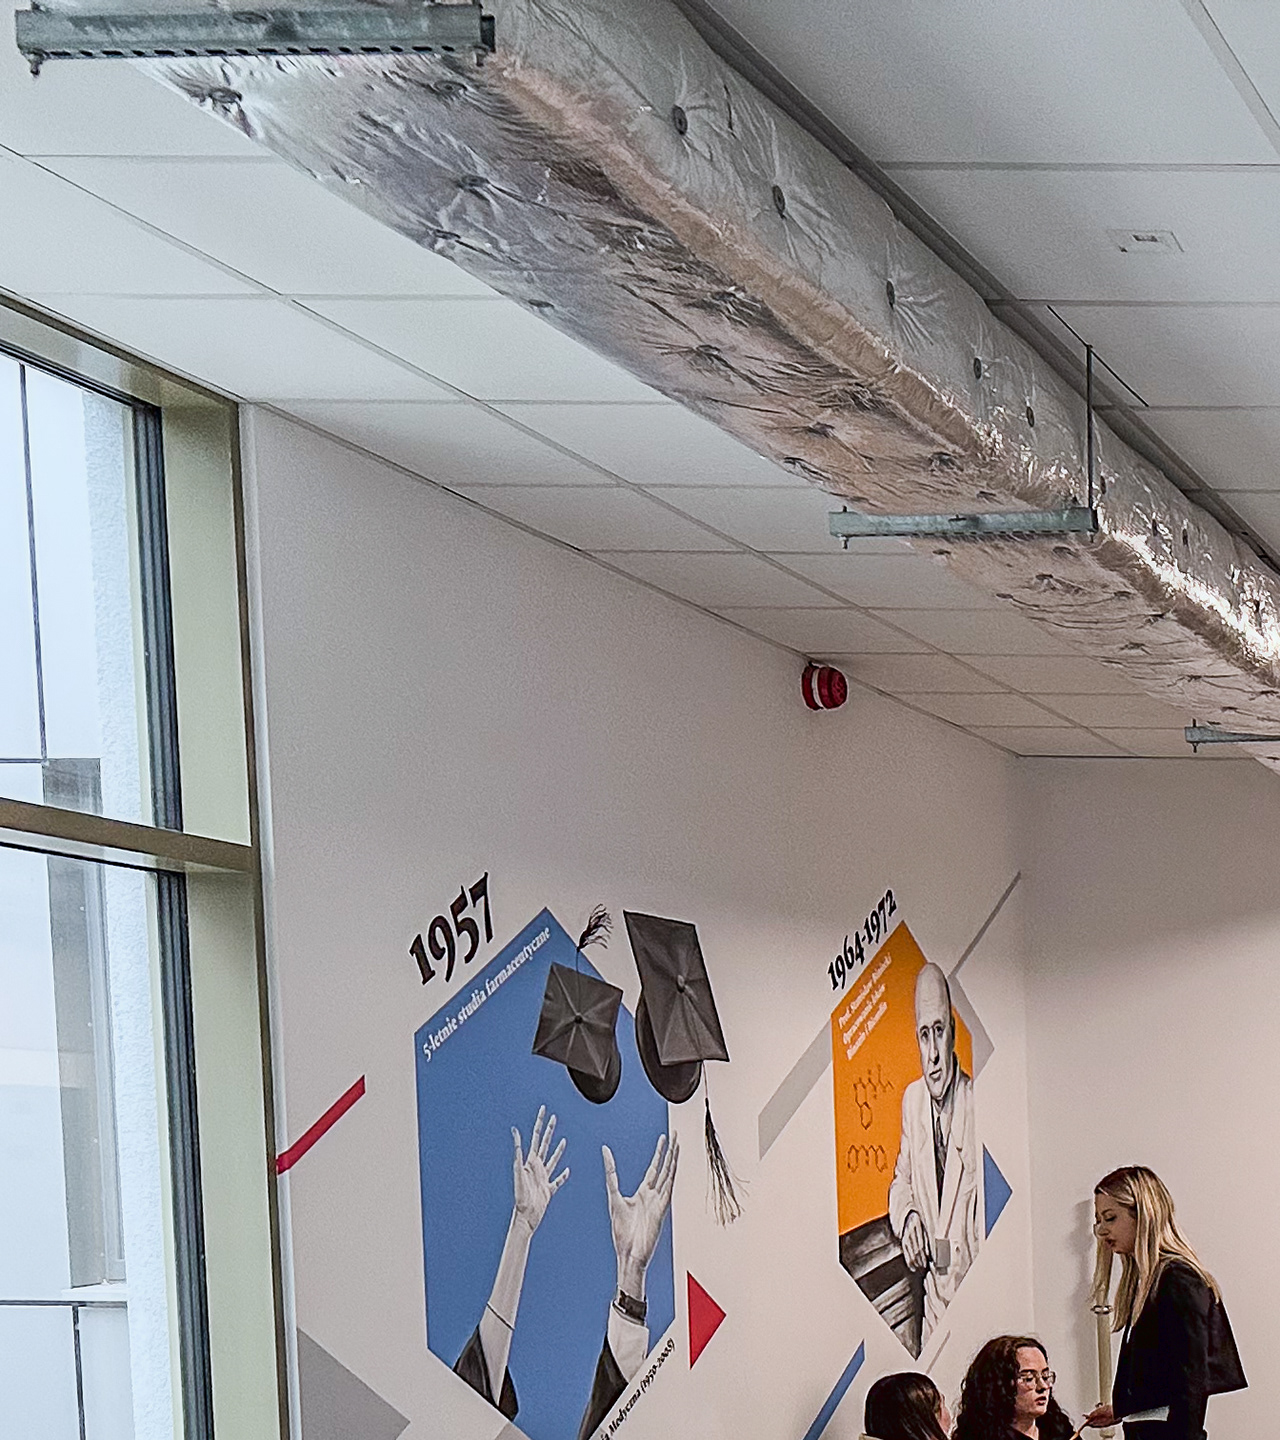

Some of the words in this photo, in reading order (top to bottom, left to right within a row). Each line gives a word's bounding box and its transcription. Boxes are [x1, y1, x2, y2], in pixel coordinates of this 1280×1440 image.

[409, 871, 494, 986] 1957
[827, 889, 897, 991] 1964-1972
[422, 1017, 458, 1062] 5-letnie
[457, 988, 487, 1025] studia
[485, 927, 551, 996] farmaceutyczne
[608, 1387, 641, 1436] Medyczna
